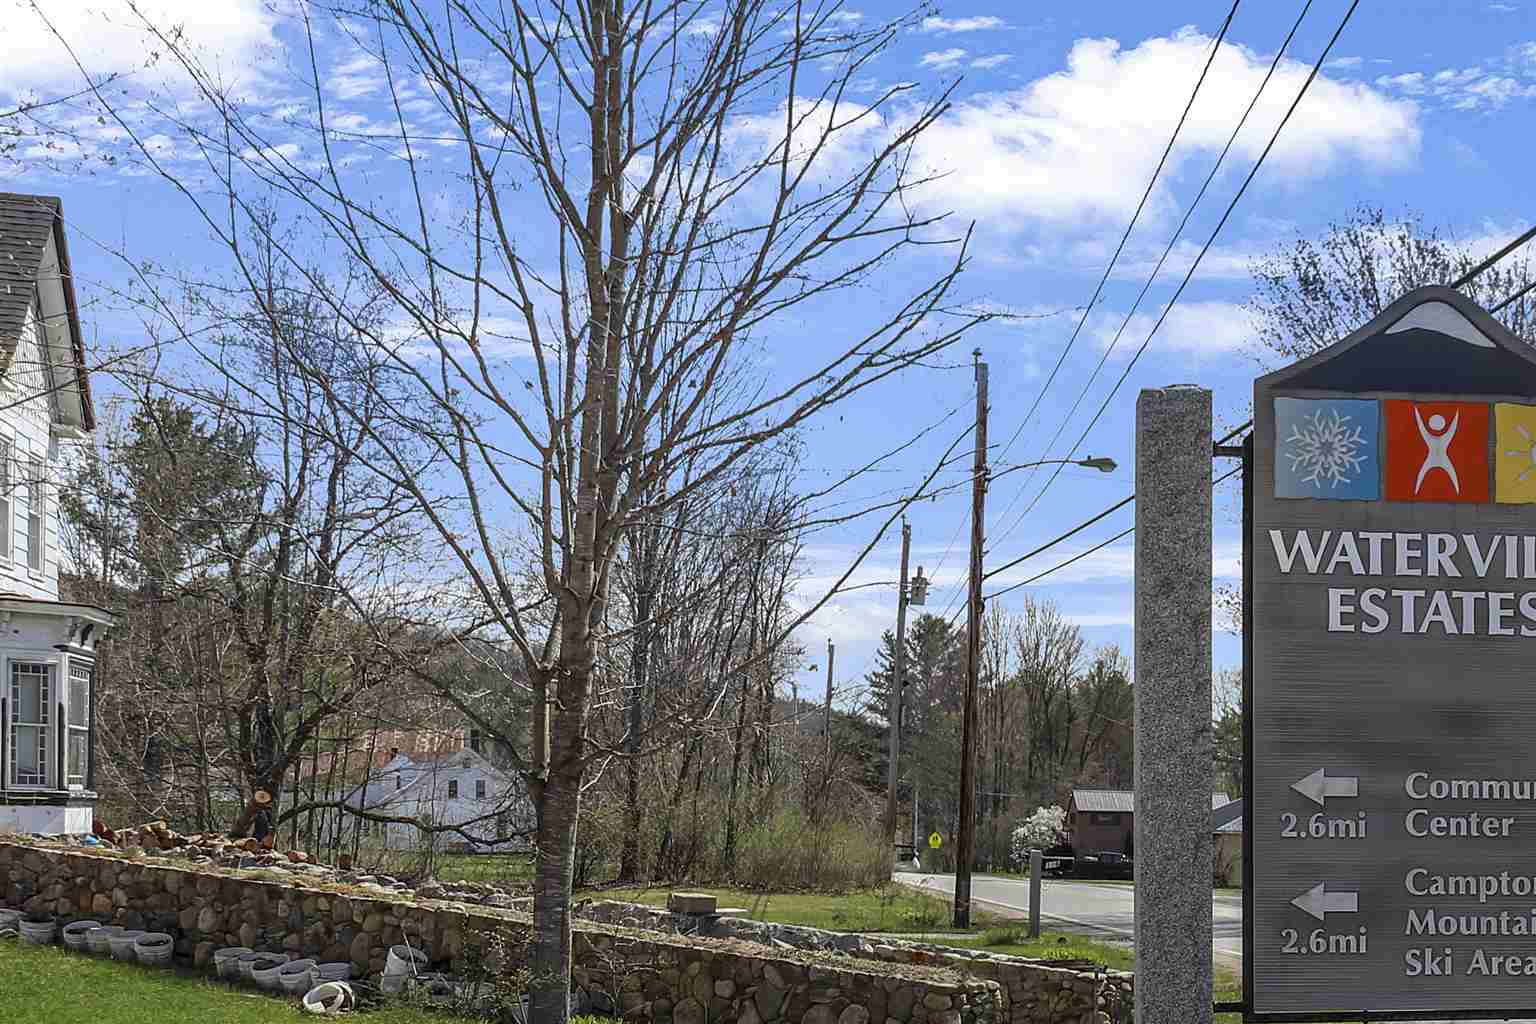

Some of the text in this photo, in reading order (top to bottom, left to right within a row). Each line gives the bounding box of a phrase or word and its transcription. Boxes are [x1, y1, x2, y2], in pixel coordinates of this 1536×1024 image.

[1280, 811, 1366, 837] 2.6mi
[1405, 809, 1514, 835] Center
[1280, 926, 1367, 952] 2.6mi
[1405, 949, 1451, 975] Ski
